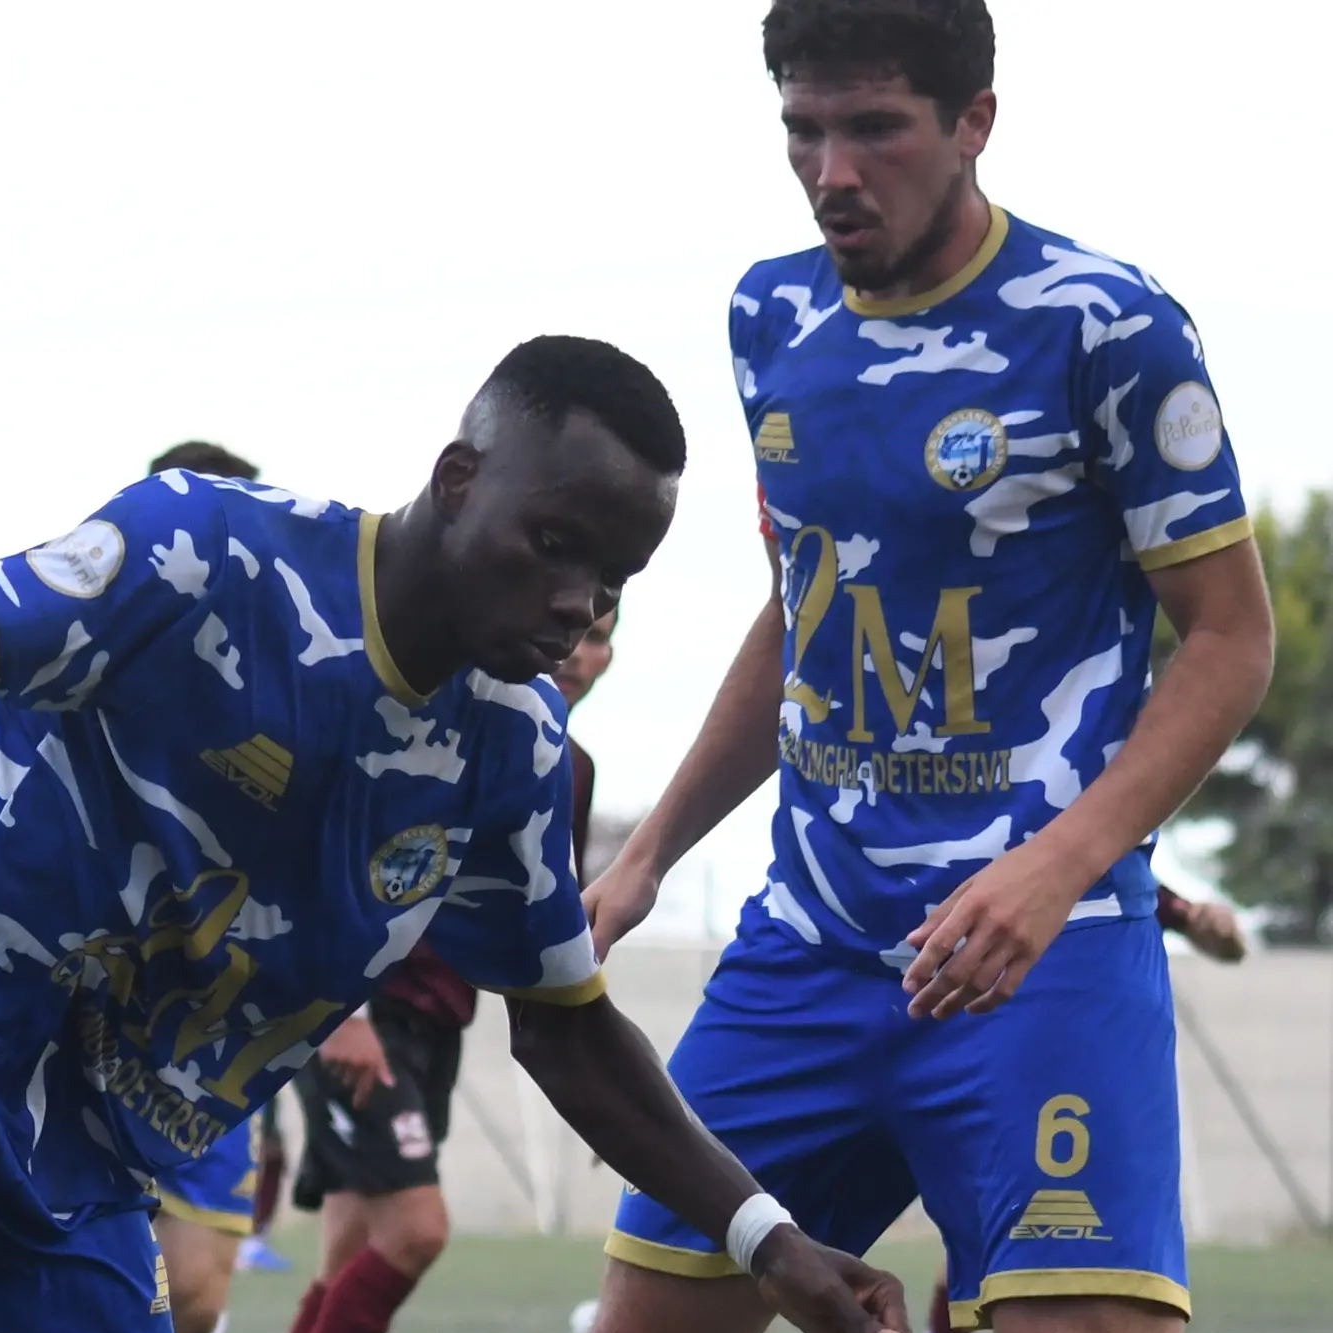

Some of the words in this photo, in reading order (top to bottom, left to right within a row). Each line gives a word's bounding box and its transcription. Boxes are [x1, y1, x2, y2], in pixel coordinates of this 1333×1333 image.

[755, 447, 800, 464] VOL
[870, 749, 1011, 795] DETERSIVI
[1034, 1092, 1092, 1179] 6
[1008, 1224, 1114, 1242] EVOL
